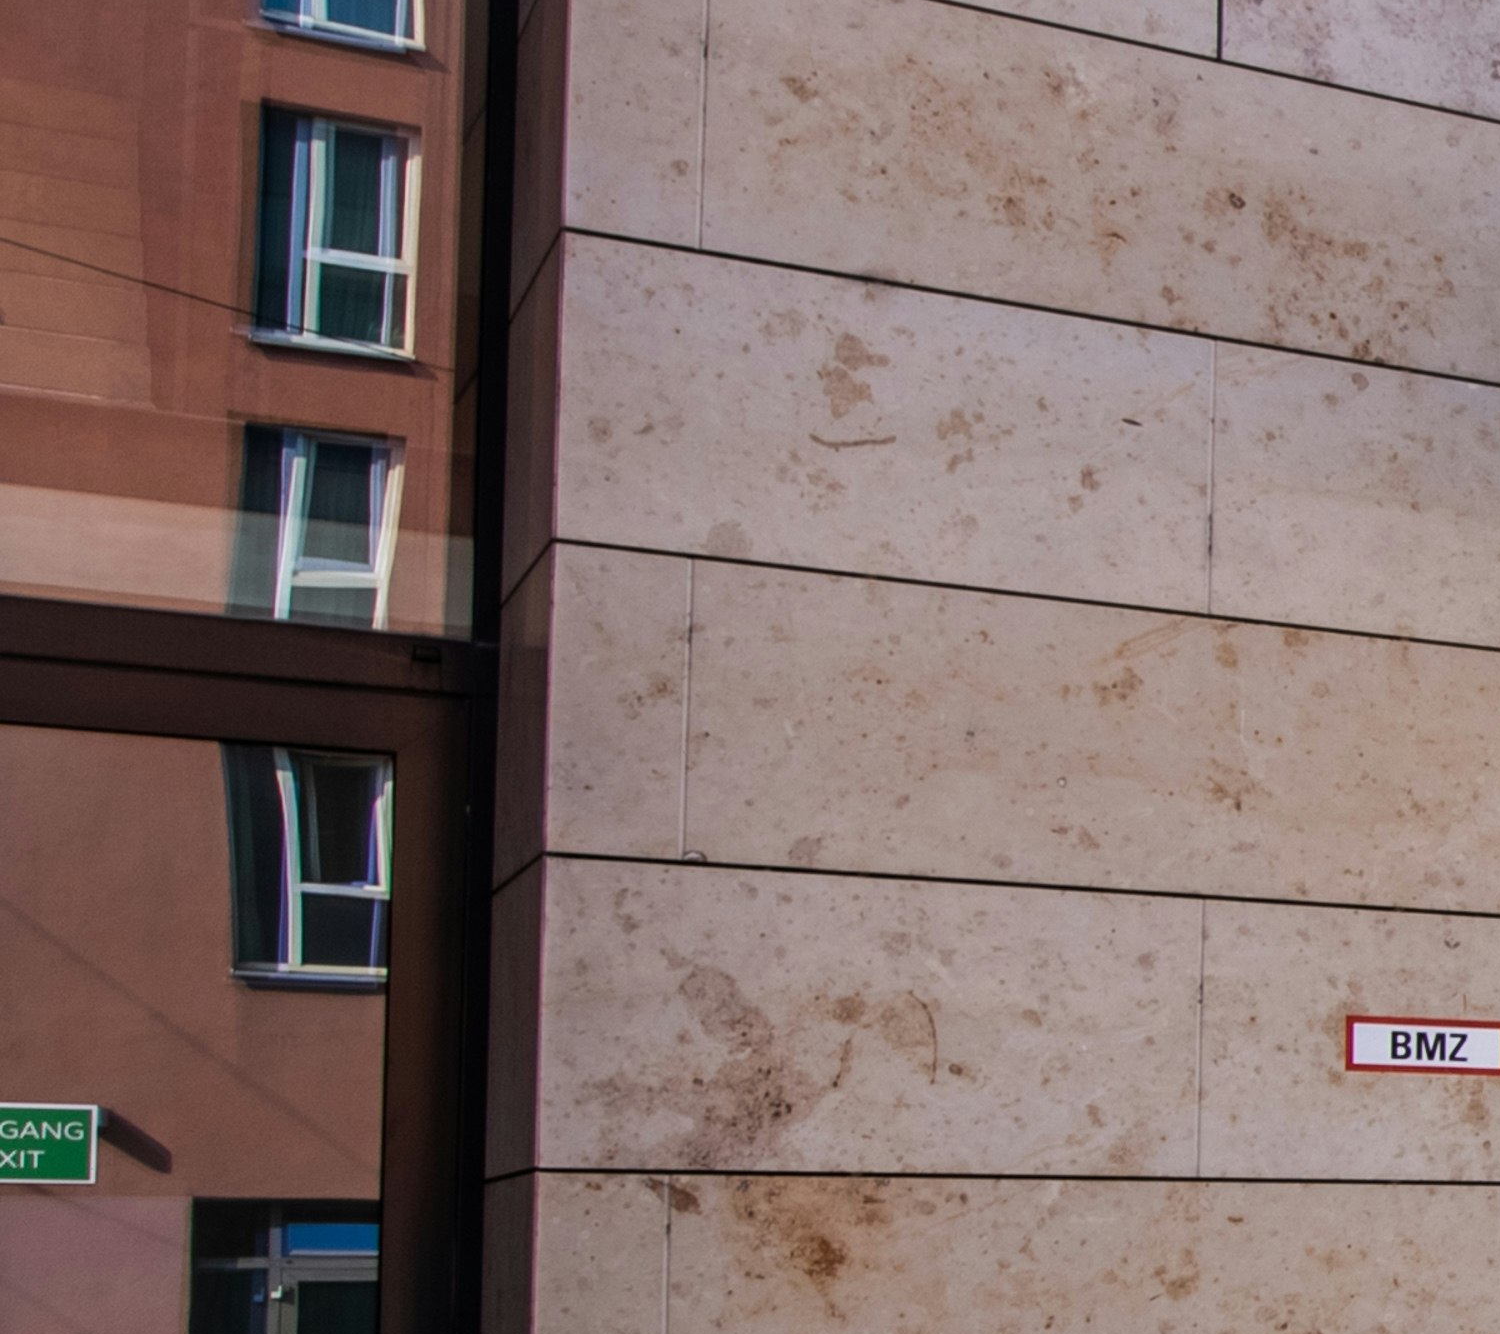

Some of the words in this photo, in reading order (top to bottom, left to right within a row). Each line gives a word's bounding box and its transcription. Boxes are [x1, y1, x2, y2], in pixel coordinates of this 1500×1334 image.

[1389, 1031, 1469, 1063] BMZ
[0, 1120, 84, 1140] GANG
[0, 1150, 45, 1168] XIT
